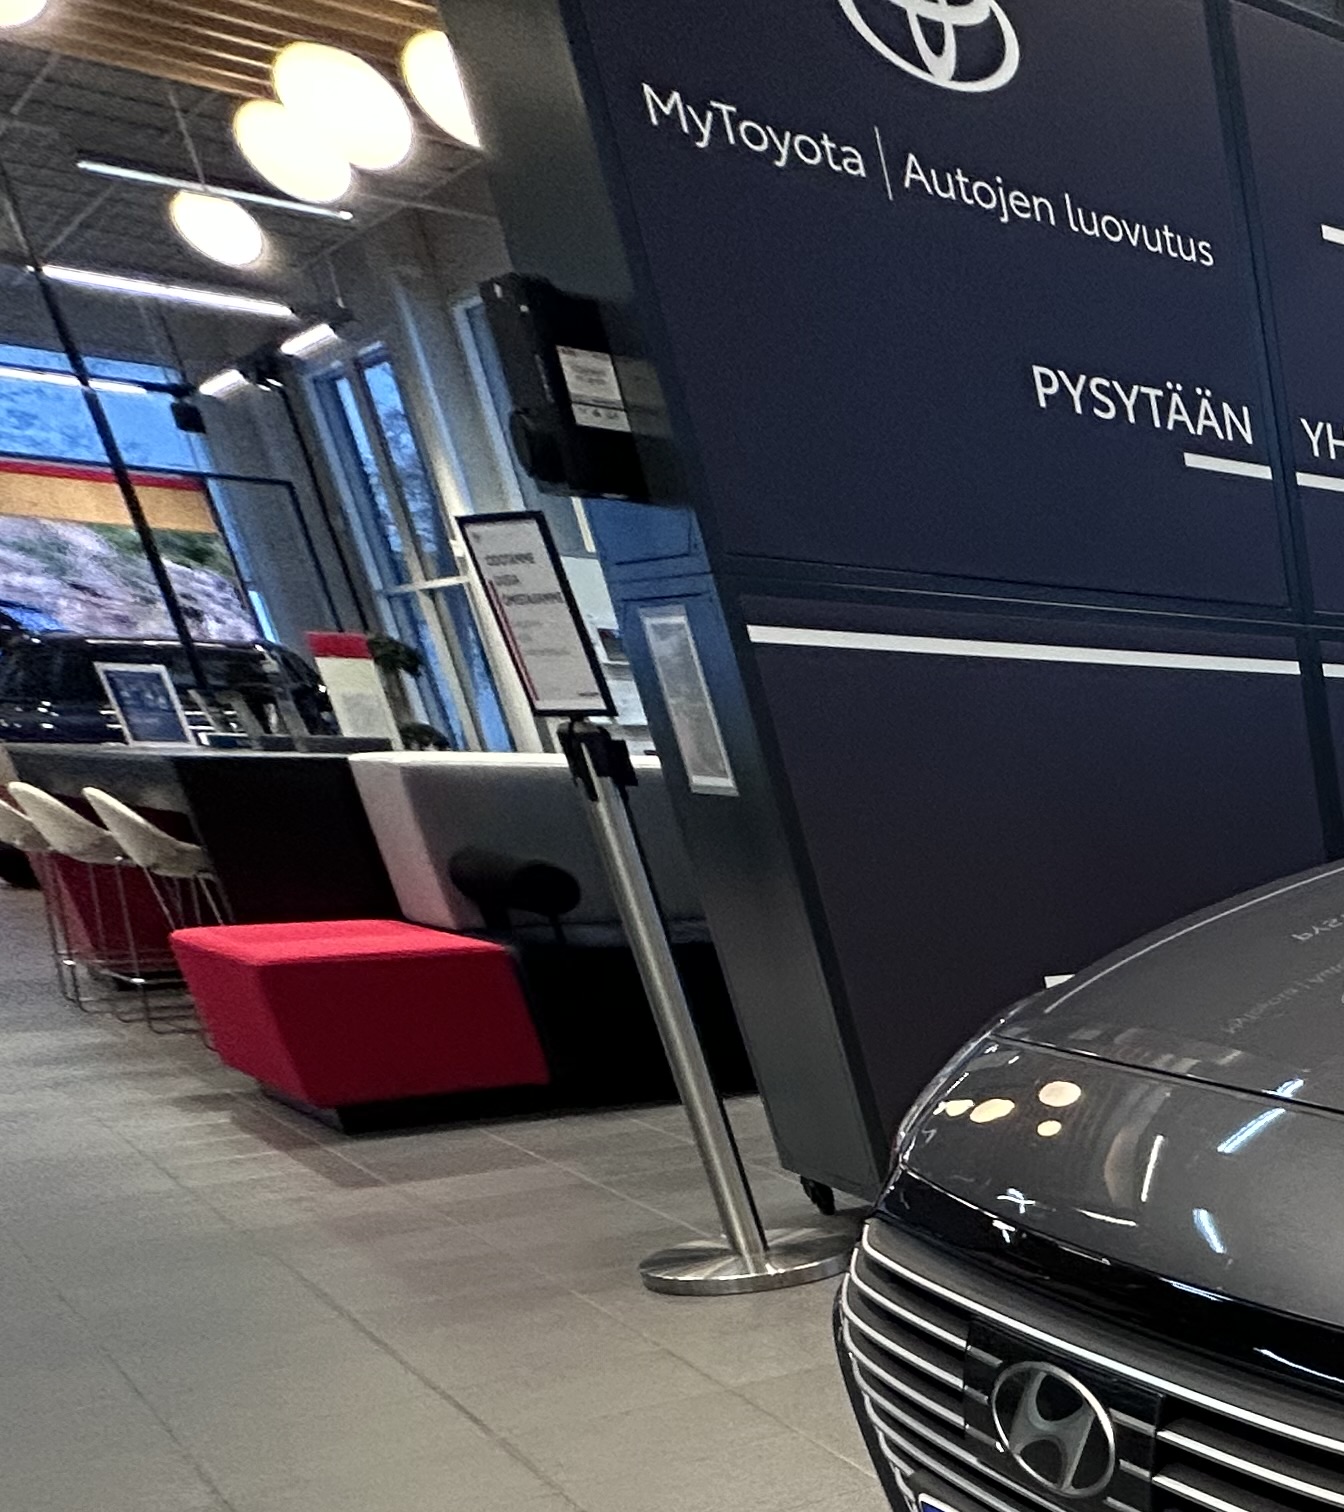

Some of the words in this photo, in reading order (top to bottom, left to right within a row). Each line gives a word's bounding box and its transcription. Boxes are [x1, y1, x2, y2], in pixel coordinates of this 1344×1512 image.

[643, 83, 866, 177] MyToyota
[904, 153, 1055, 225] Autojen
[1065, 193, 1214, 266] luovutus
[1032, 365, 1253, 444] PYSYTÄÄN
